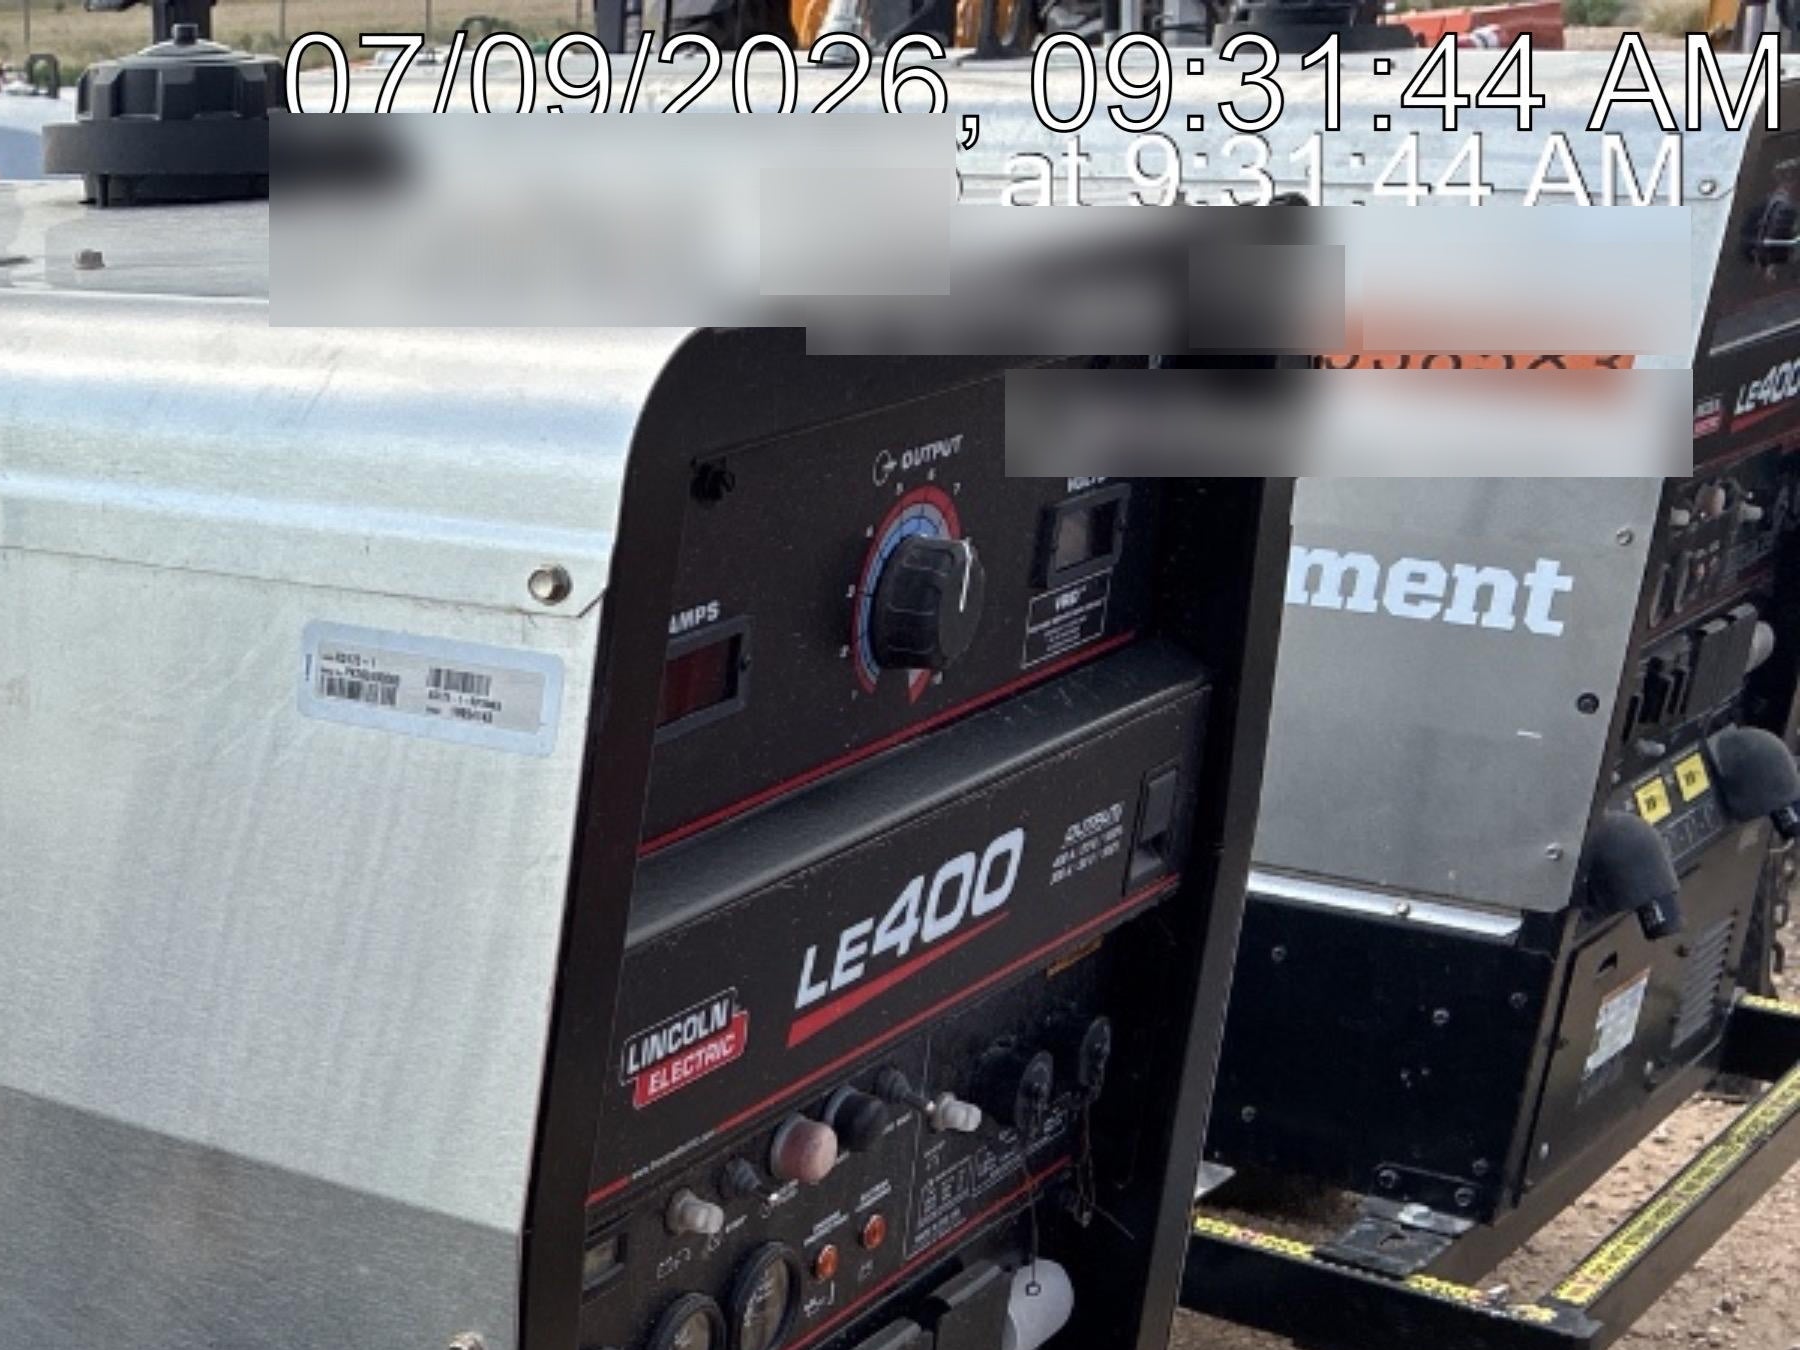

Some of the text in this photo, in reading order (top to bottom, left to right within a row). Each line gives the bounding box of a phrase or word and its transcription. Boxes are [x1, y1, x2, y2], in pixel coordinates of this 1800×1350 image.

[901, 435, 964, 470] OUTPUT
[794, 826, 1026, 1010] LE400
[627, 998, 731, 1074] LINCOLN
[648, 1034, 736, 1097] ELECTRIC
